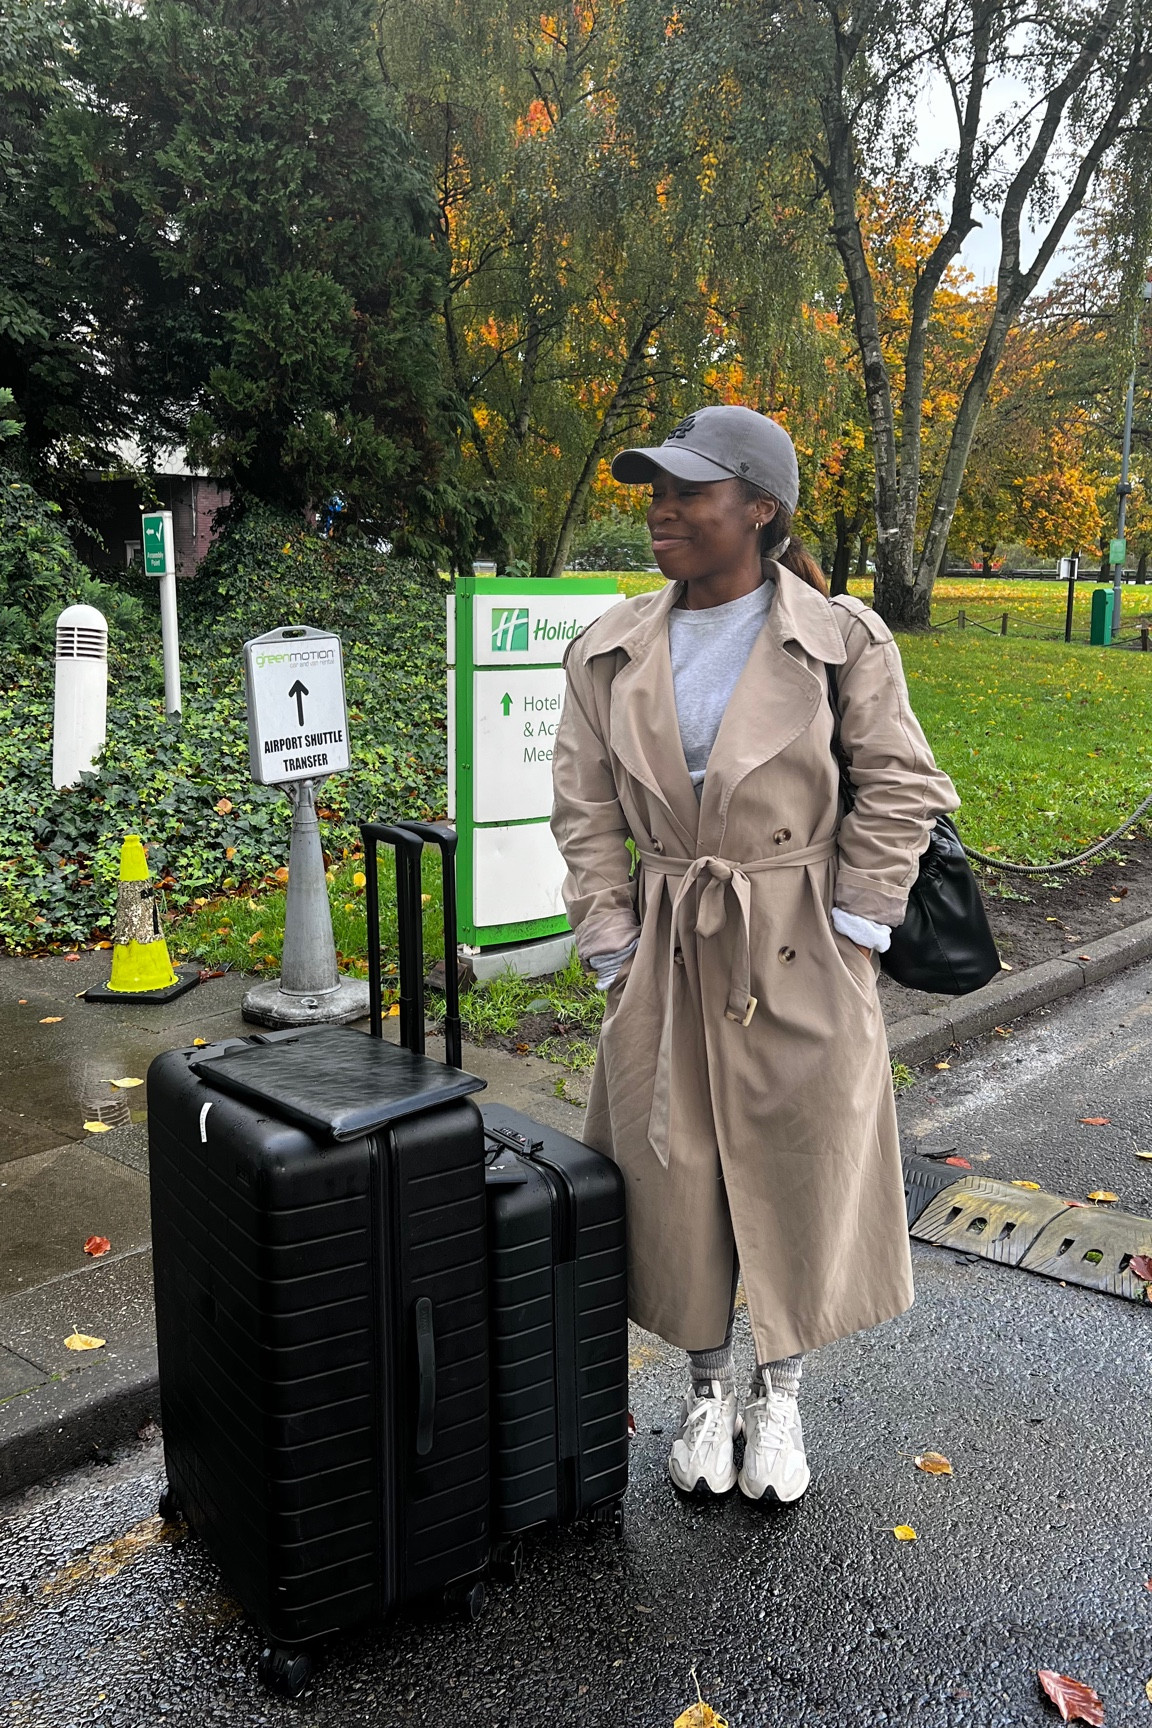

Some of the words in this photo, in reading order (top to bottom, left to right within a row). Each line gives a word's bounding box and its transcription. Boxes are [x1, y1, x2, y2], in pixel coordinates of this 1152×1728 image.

[146, 551, 164, 560] Assembly
[151, 559, 161, 567] Point
[300, 660, 310, 668] and
[523, 693, 561, 712] Hotel
[523, 721, 534, 738] &
[264, 735, 303, 755] AIRPORT
[304, 729, 343, 748] SHUTTLE
[283, 752, 329, 772] TRANSFER
